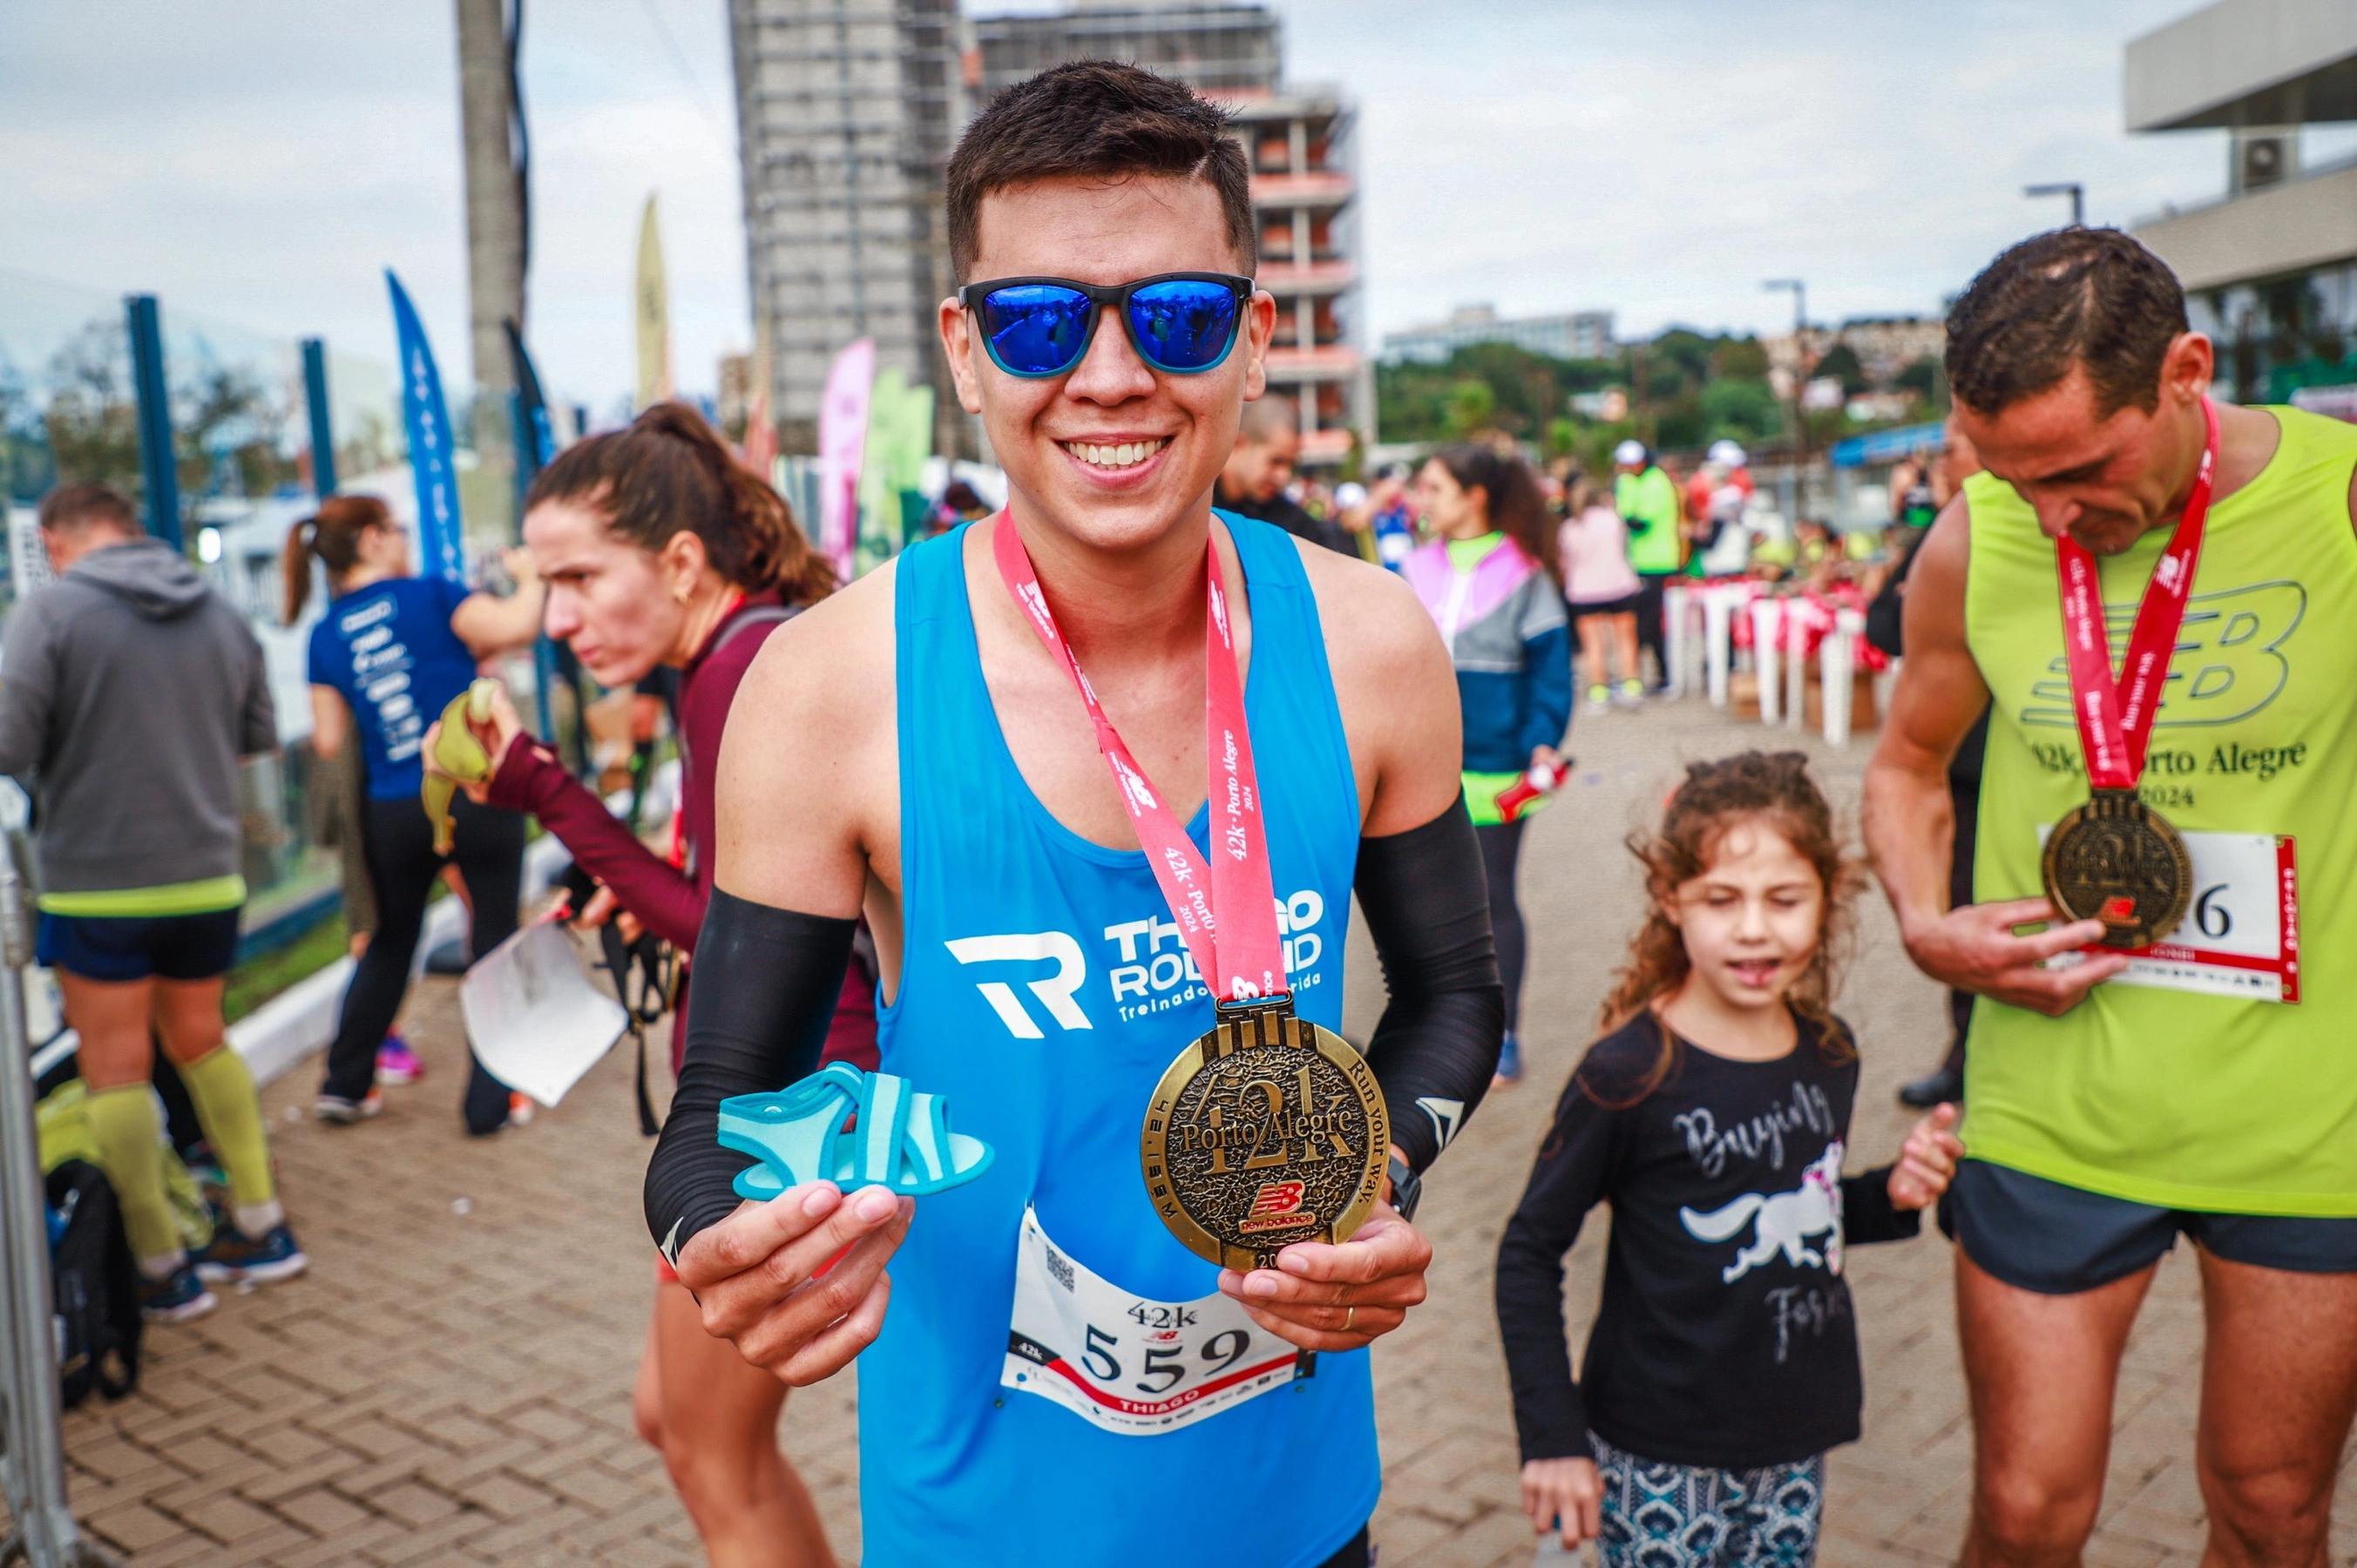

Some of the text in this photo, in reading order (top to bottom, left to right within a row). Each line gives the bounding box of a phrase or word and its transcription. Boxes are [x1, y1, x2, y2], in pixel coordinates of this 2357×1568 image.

[2146, 749, 2196, 774] rto
[2206, 740, 2307, 782] Alegre
[1223, 729, 1248, 862] 42k Porto Alegre
[1242, 785, 1254, 813] 2024
[2138, 786, 2196, 808] 2024
[1164, 846, 1216, 930] 42k Porto
[1179, 904, 1201, 934] 2024
[1119, 985, 1209, 1023] Treinado
[1181, 1108, 1353, 1152] Porto Alegre
[1348, 1058, 1385, 1204] Run your way.
[1242, 1214, 1313, 1231] new balance
[1258, 1253, 1278, 1268] 20
[1127, 1301, 1198, 1328] 42k
[1018, 1342, 1044, 1362] 42k
[1080, 1322, 1251, 1394] 559
[1120, 1389, 1200, 1415] THIAGO
